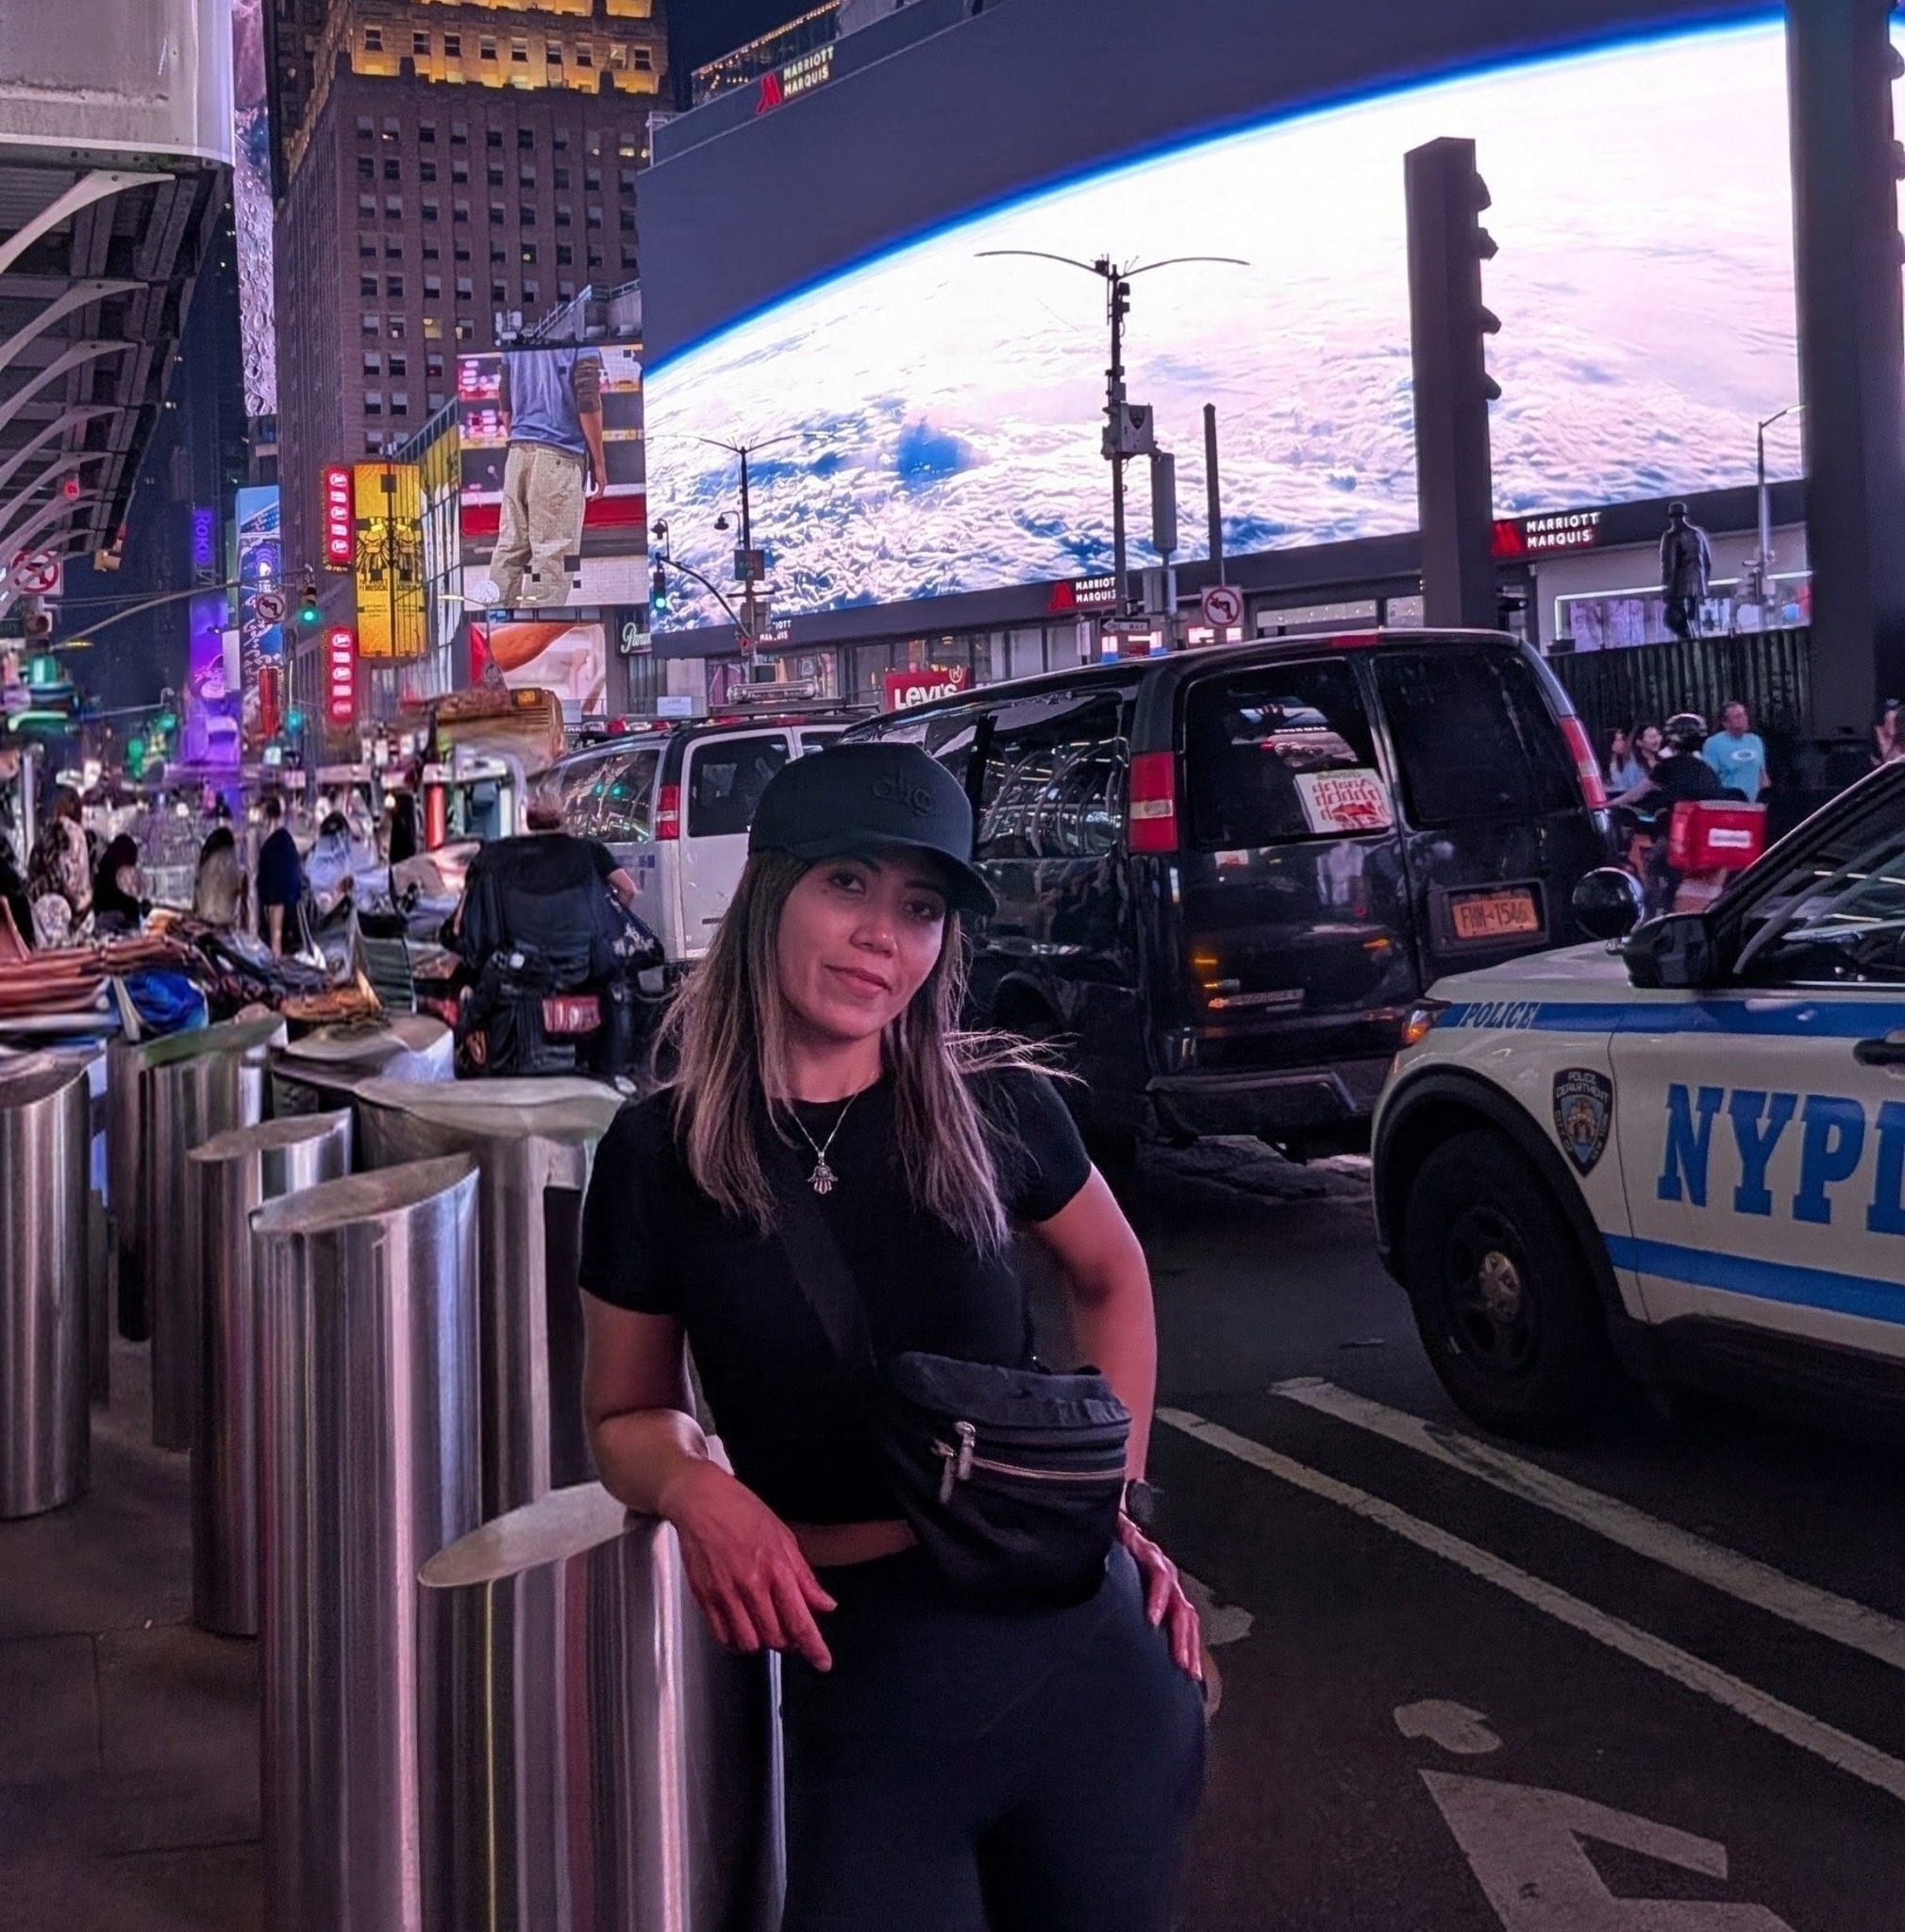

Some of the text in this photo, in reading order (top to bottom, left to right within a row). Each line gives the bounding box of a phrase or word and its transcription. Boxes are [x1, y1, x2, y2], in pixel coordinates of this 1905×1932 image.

[783, 45, 834, 81] MARRIOTT
[784, 63, 829, 97] MARQUIS
[1526, 511, 1602, 534] MARRIOTT
[1527, 527, 1593, 549] MARQUIS
[1075, 576, 1116, 591] MARRIOT
[1459, 1001, 1540, 1029] POLICE
[1567, 1071, 1596, 1085] POLICE
